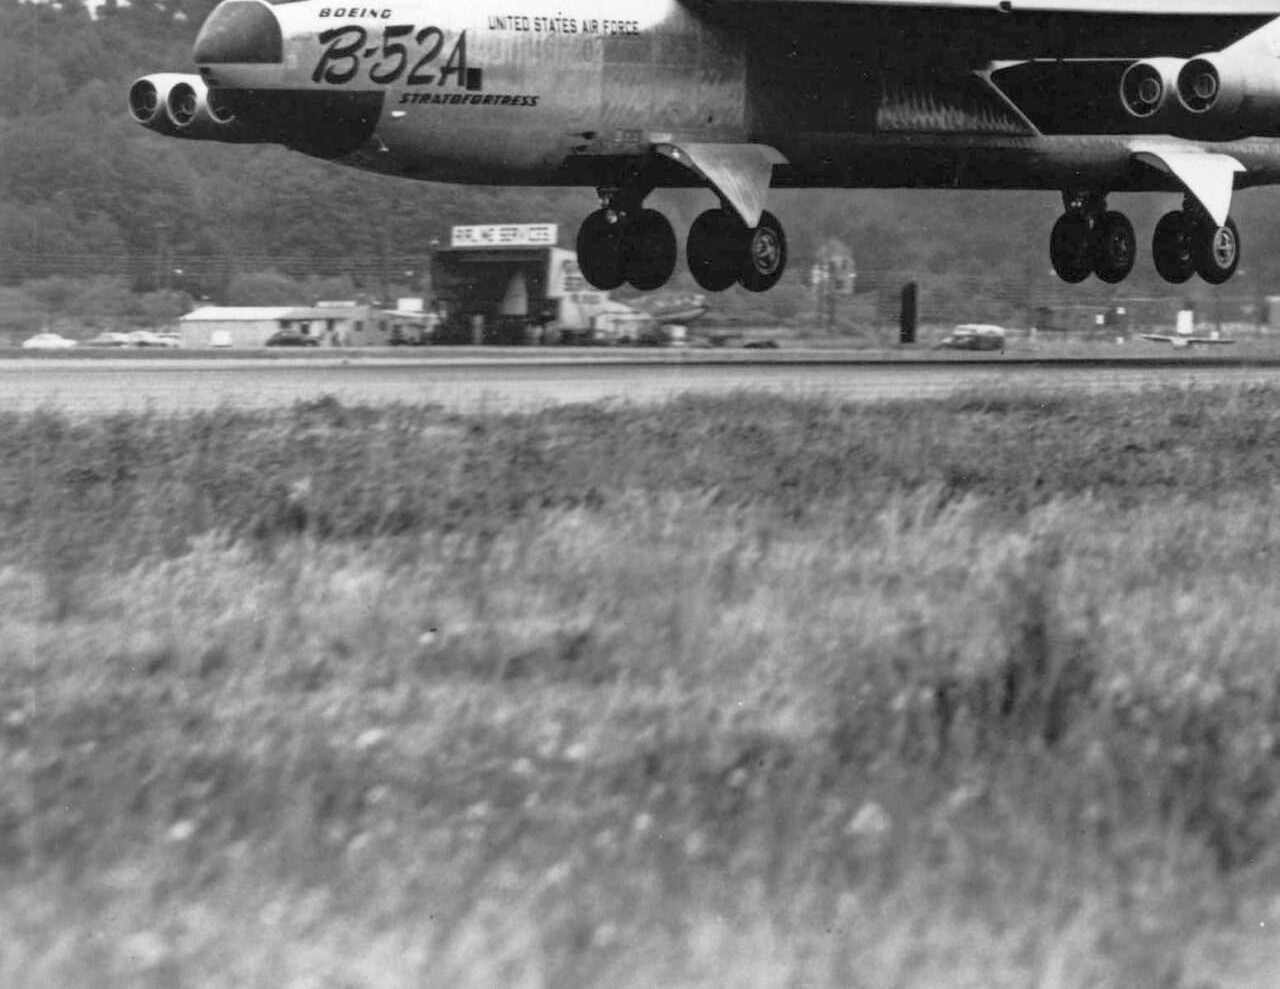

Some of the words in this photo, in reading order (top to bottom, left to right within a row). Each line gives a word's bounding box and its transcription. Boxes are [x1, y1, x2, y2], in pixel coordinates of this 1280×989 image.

[319, 7, 392, 19] BOEING
[488, 16, 530, 31] UNITED
[534, 17, 577, 34] STATES
[582, 19, 599, 35] AIR
[602, 20, 640, 36] FORCE
[312, 24, 467, 86] B-52A
[398, 93, 540, 107] STRATOFORTRESS
